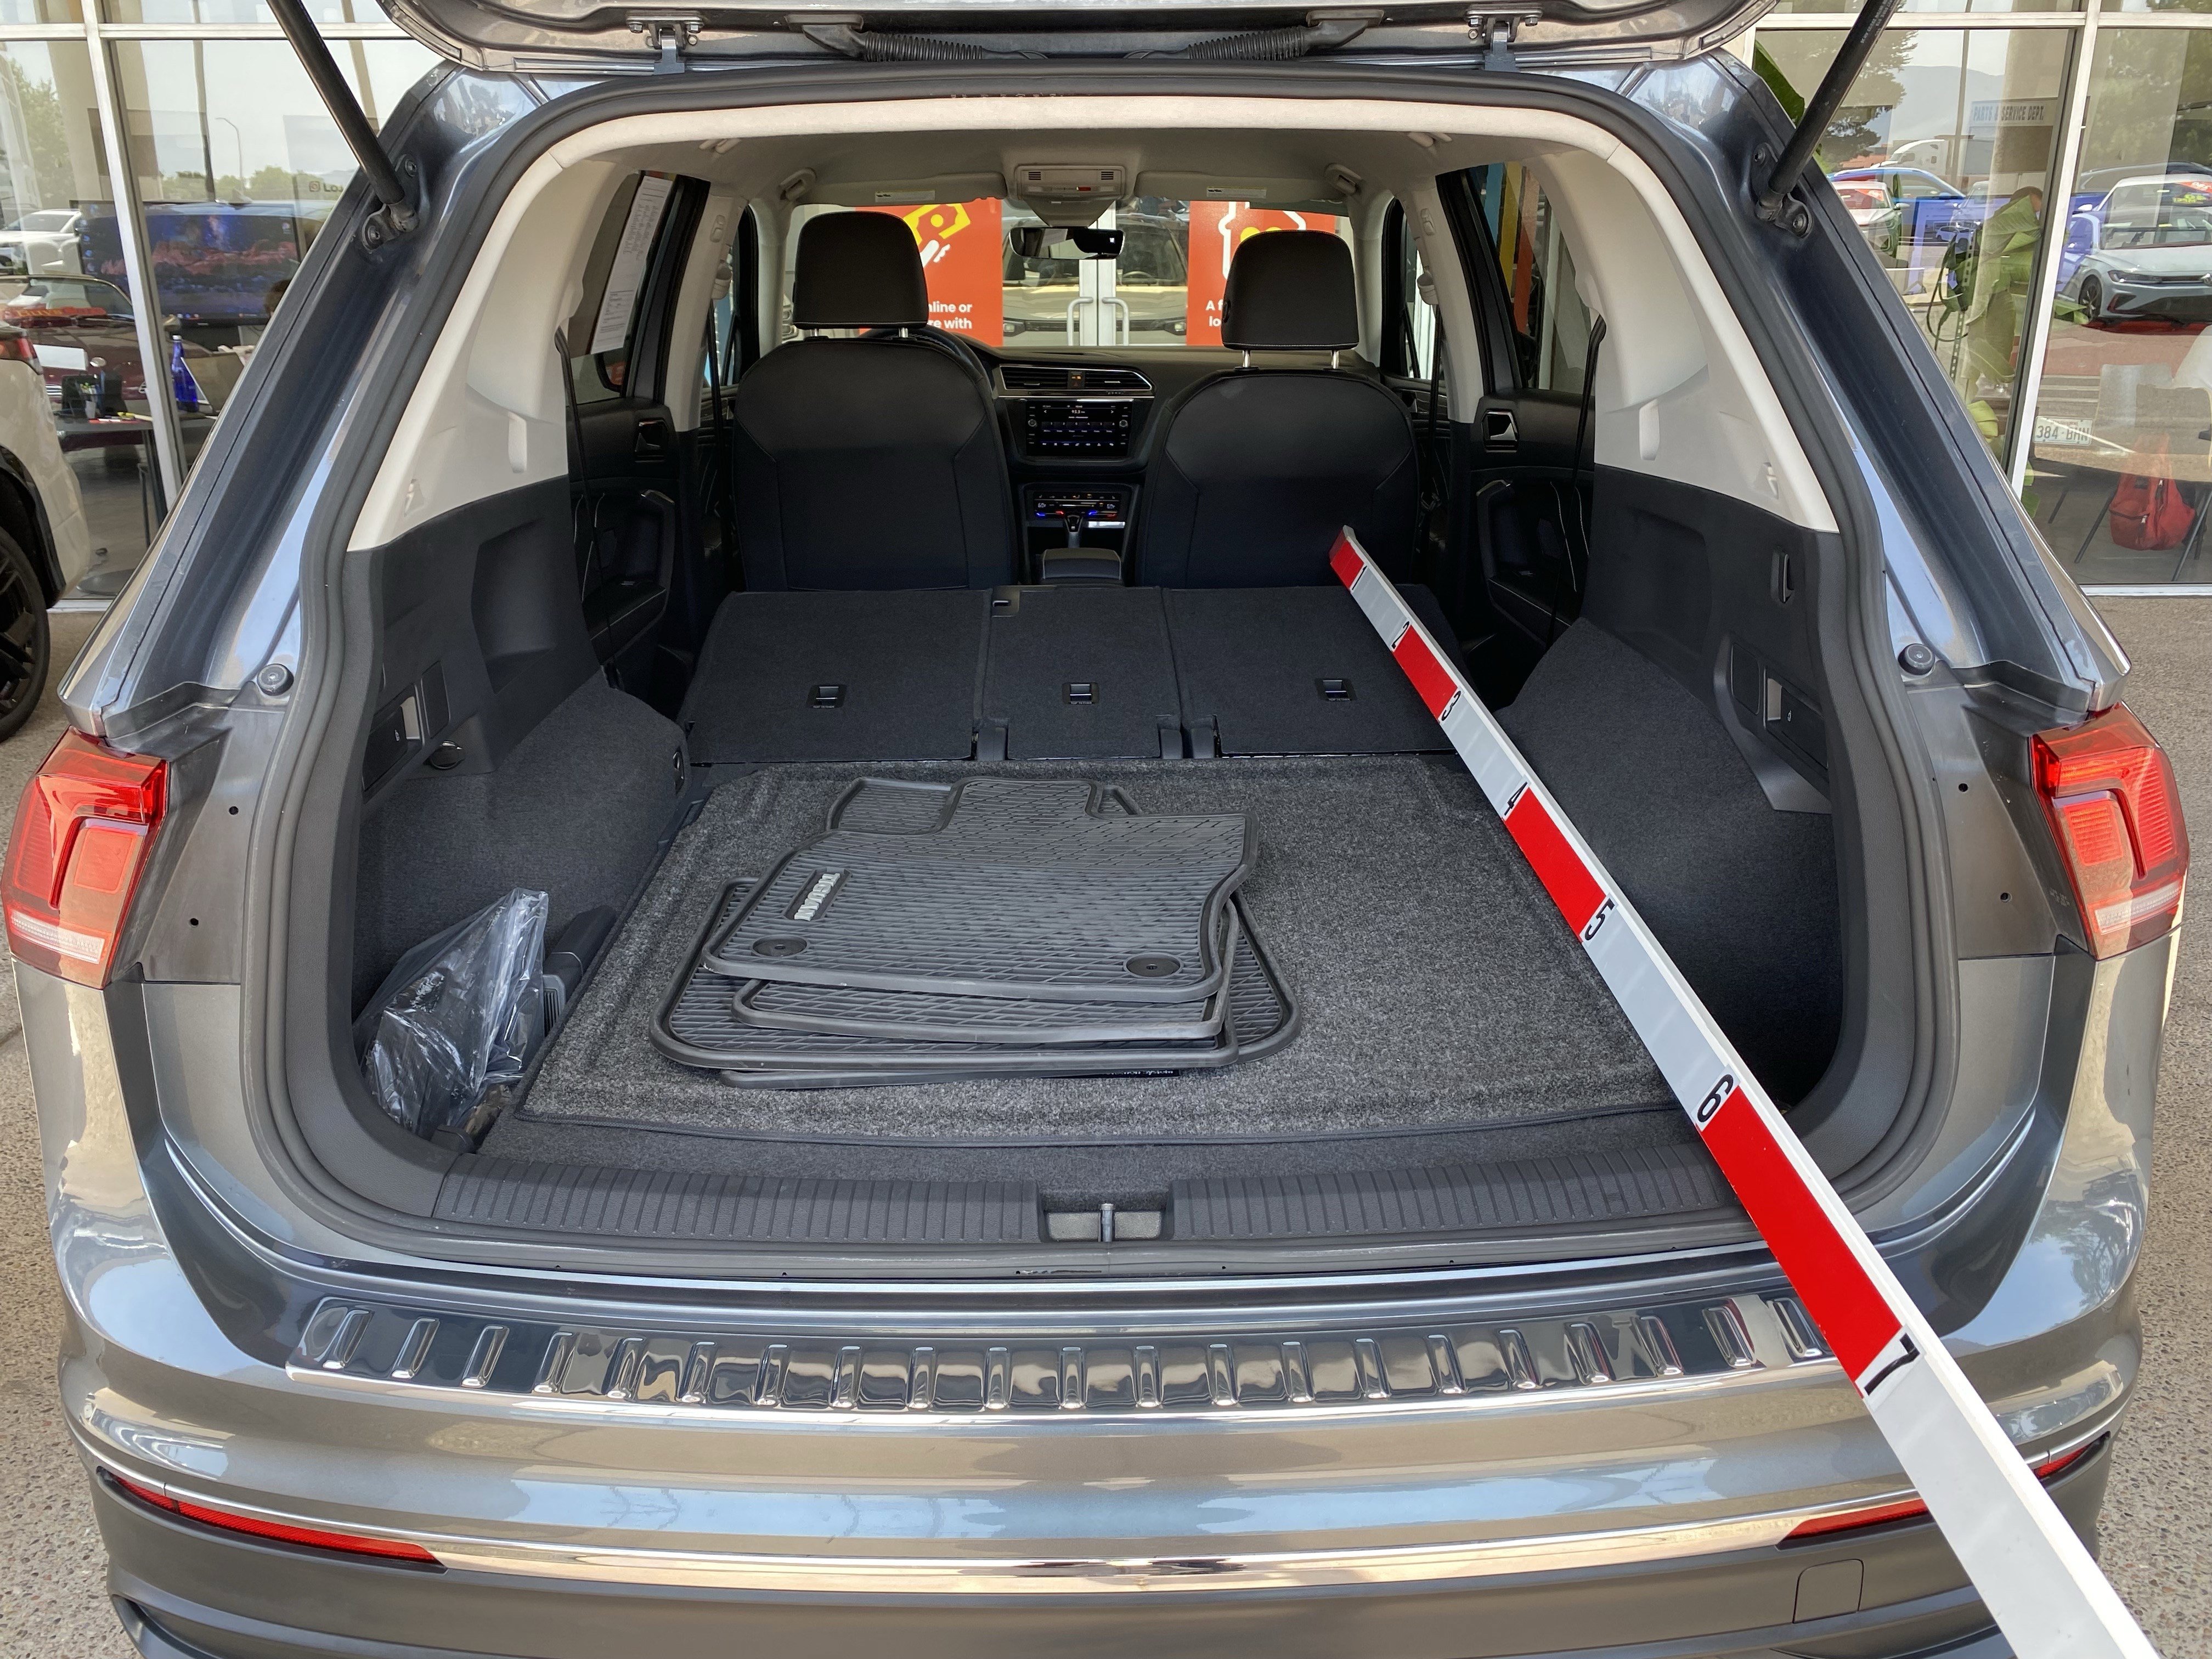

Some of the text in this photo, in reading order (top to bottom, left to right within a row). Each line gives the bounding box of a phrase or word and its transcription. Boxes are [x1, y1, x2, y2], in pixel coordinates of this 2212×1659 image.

[1973, 105, 1993, 121] PARTS
[2001, 105, 2027, 121] SERVICE
[2027, 105, 2045, 121] DEPT.
[958, 304, 973, 313] or
[1205, 300, 1216, 311] A
[944, 317, 973, 329] with
[1352, 565, 1368, 591] 1
[1391, 620, 1410, 650] 2
[1441, 691, 1462, 721] 3
[1504, 781, 1528, 816] 4
[794, 873, 840, 921] TIGUAN
[1584, 898, 1615, 940] 5
[1697, 1074, 1734, 1122] 6
[1864, 1332, 1921, 1396] 7
